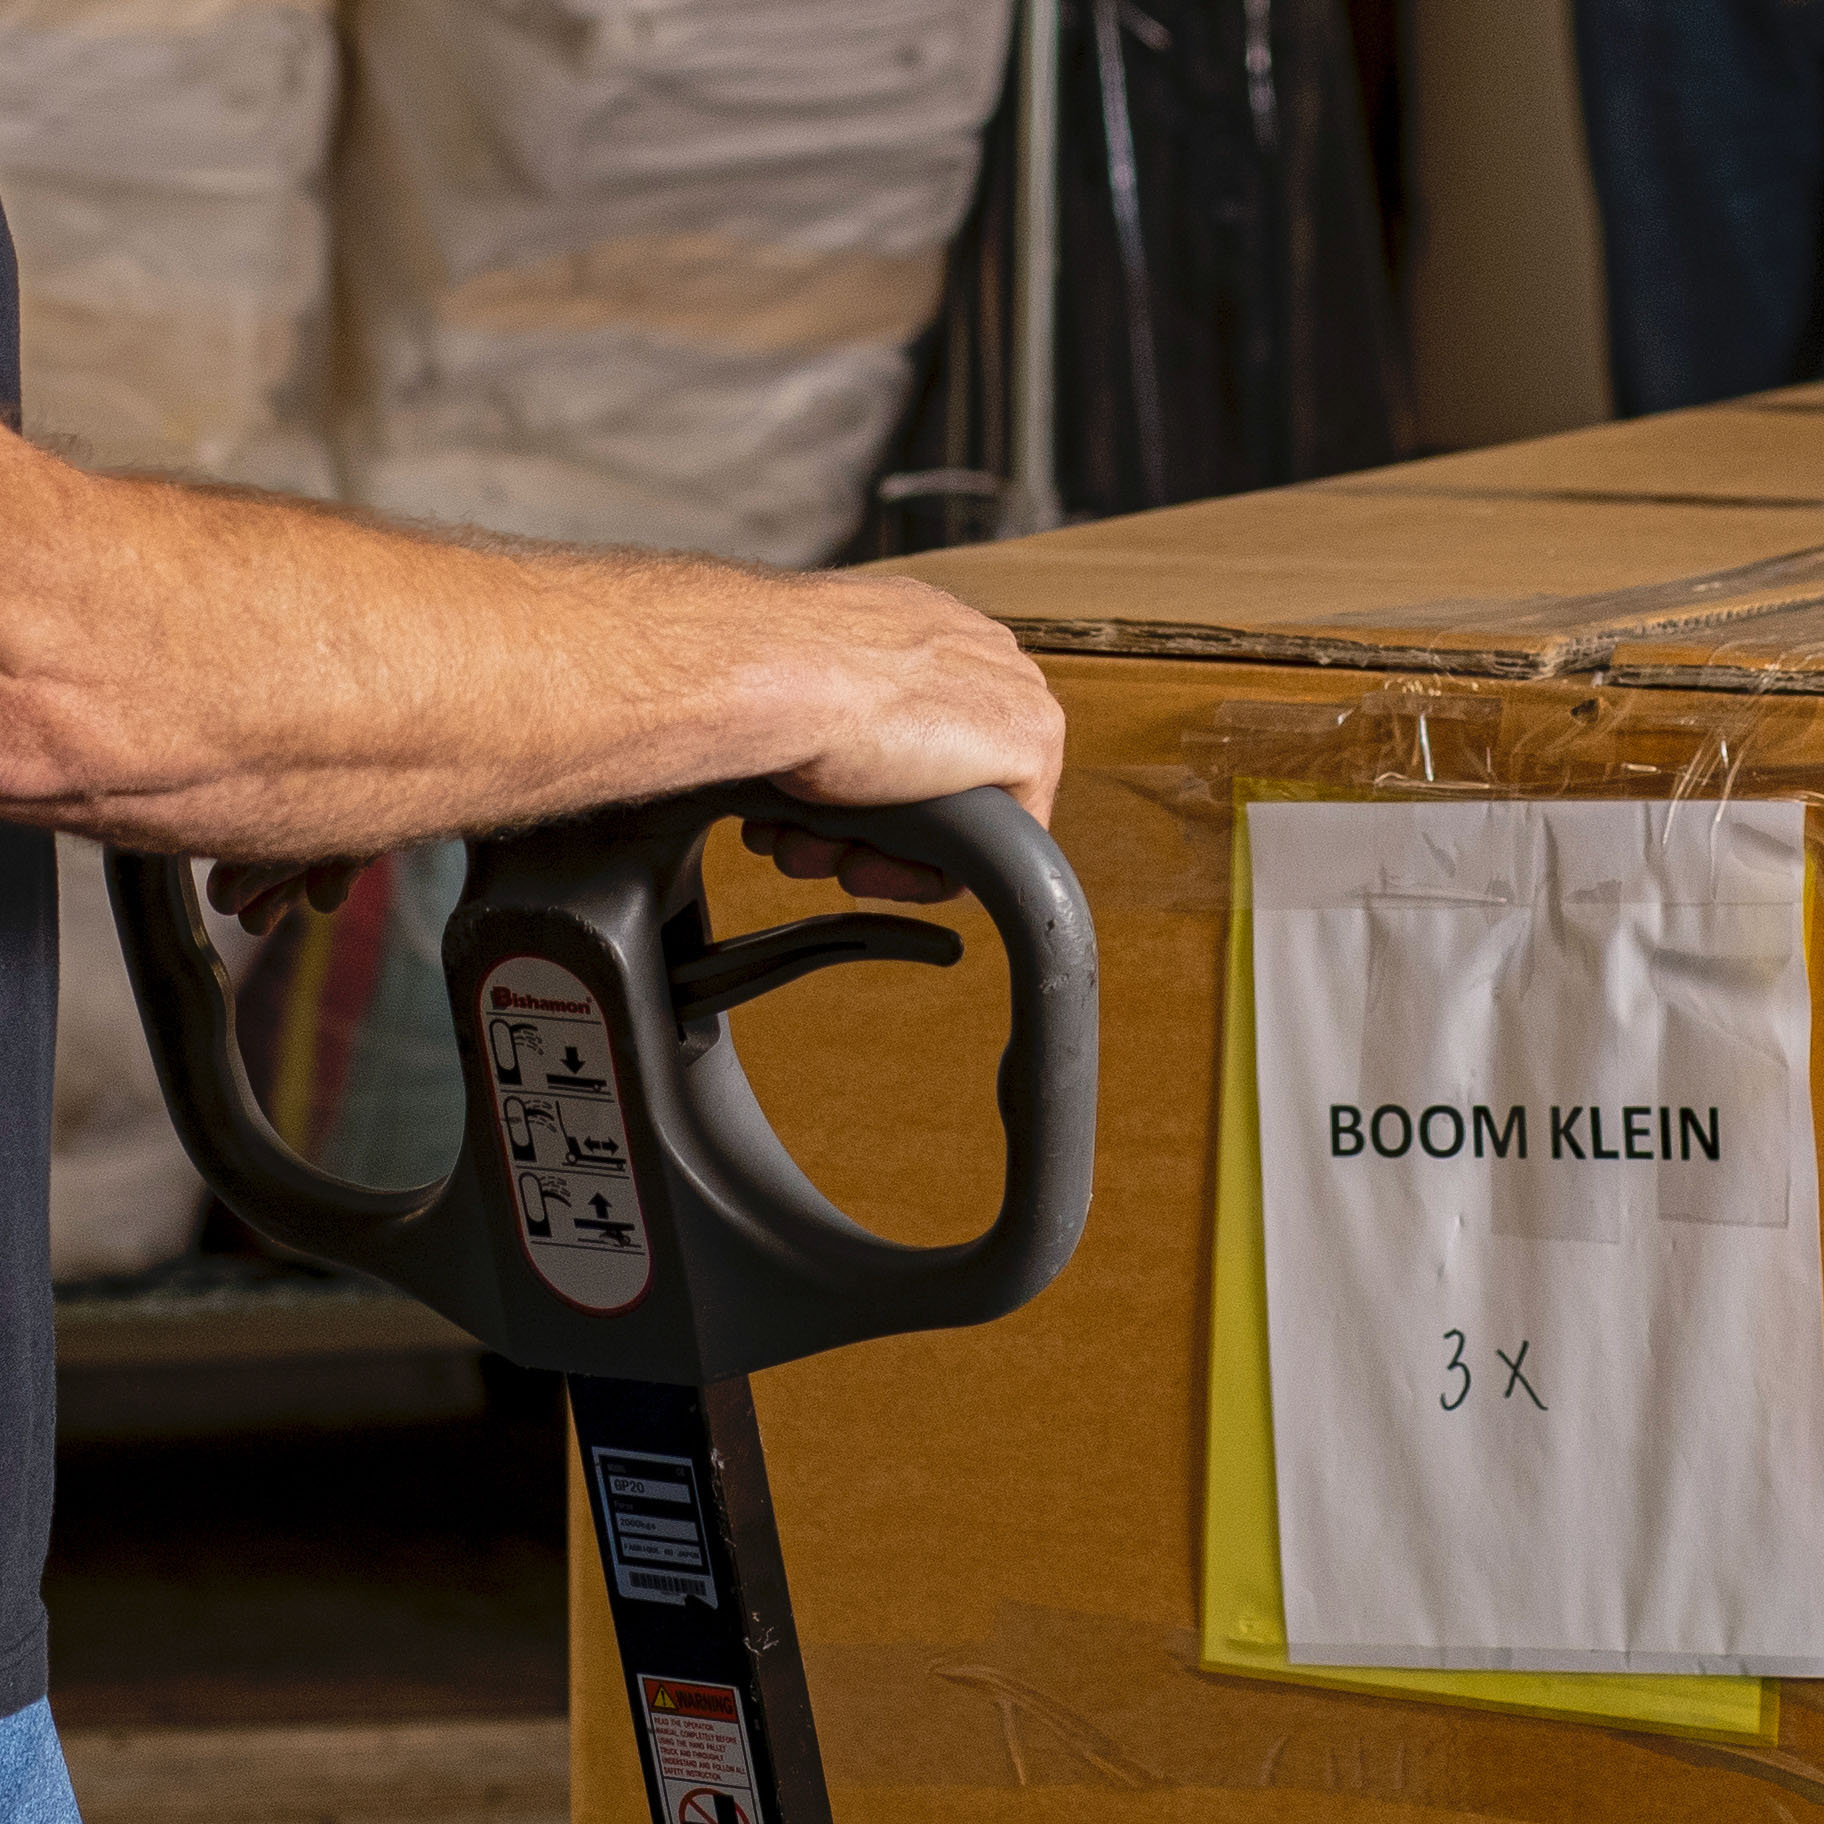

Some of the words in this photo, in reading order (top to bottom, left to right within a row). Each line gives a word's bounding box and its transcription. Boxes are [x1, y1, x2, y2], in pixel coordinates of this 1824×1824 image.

[489, 985, 592, 1015] Bishamon
[1330, 1103, 1529, 1160] BOOM
[1549, 1104, 1722, 1162] KLEIN
[1439, 1328, 1472, 1412] 3
[674, 1689, 736, 1715] WARNING
